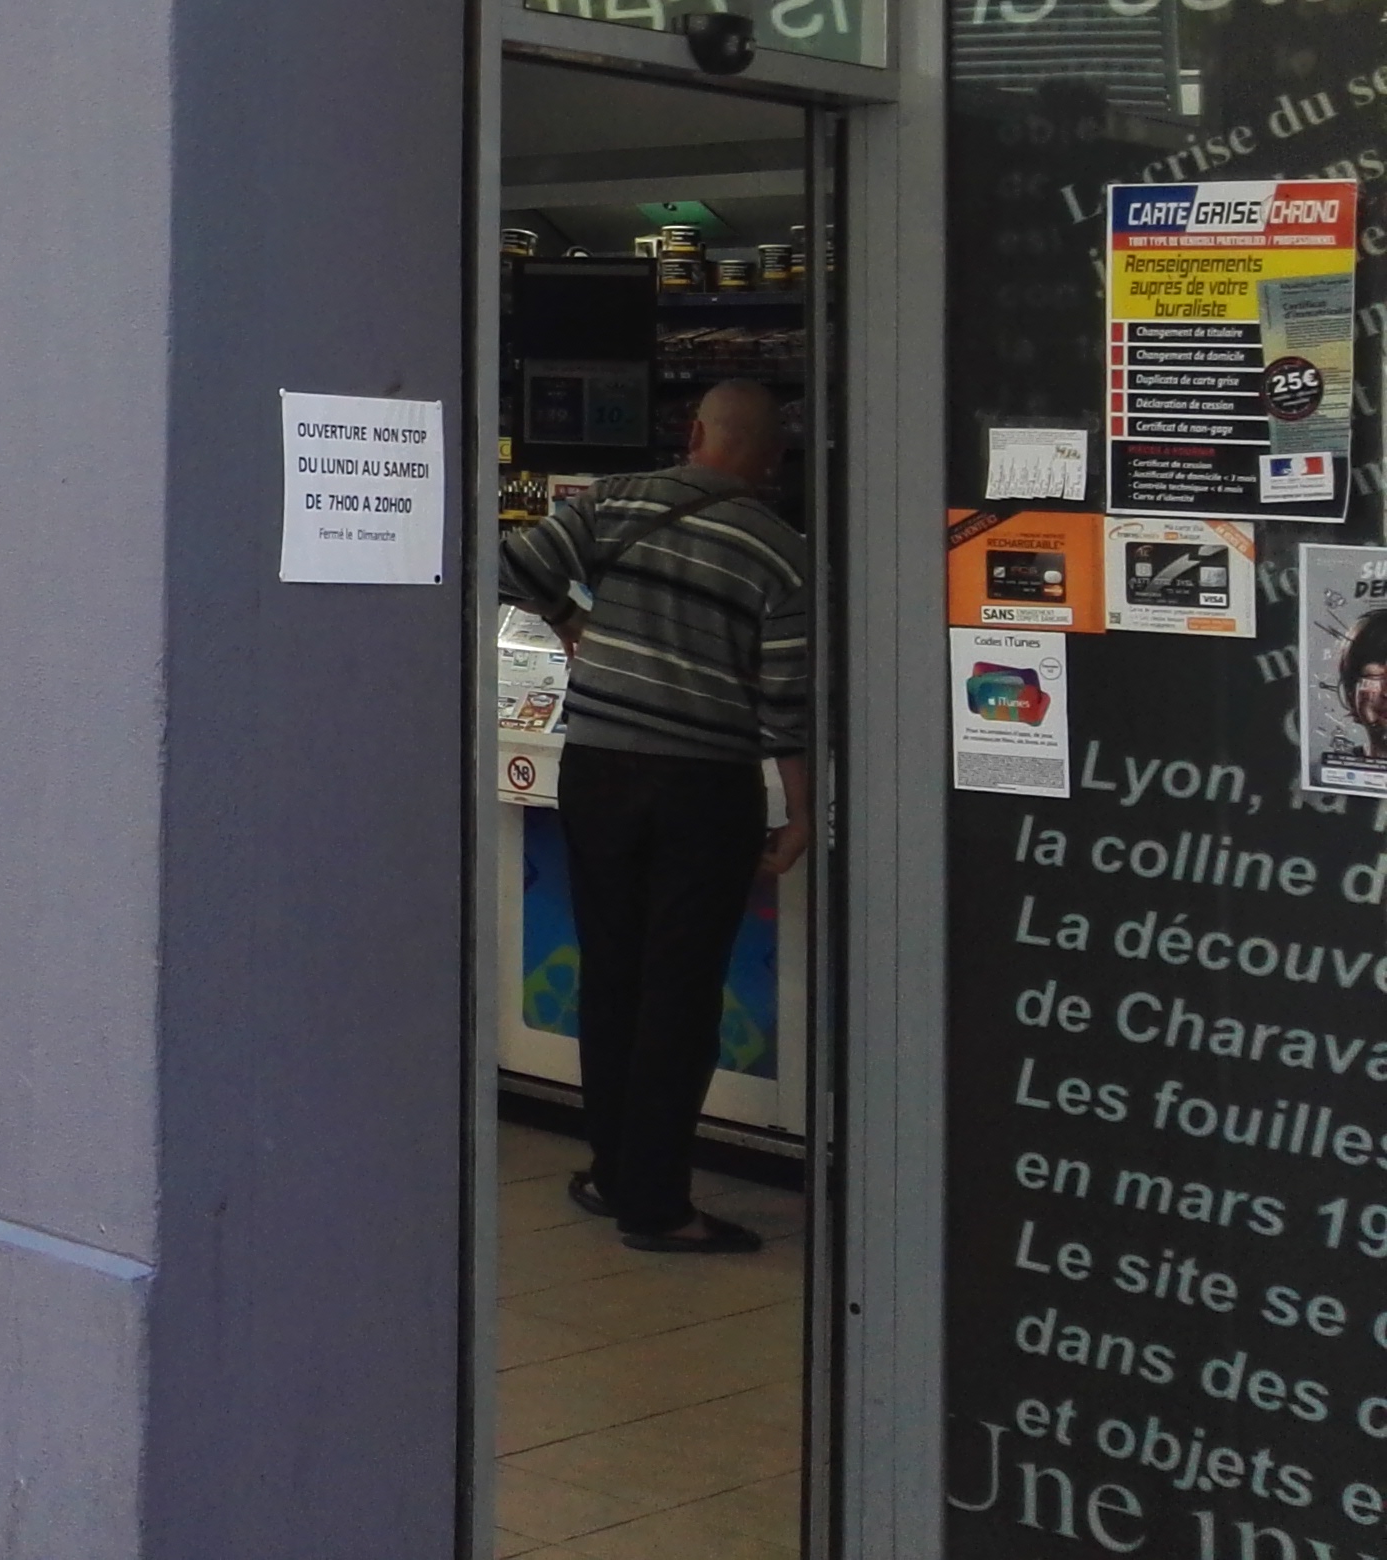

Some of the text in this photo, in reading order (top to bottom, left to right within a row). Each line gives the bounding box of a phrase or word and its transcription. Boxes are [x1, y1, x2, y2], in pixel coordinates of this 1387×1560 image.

[1267, 90, 1339, 139] du
[1128, 199, 1340, 226] CARTE GRISE CHRONO
[1125, 254, 1263, 278] Renseignements
[1130, 274, 1248, 300] auprès de votre
[1154, 298, 1227, 318] buraliste
[1135, 326, 1243, 341] Changement de titulaire
[1135, 349, 1245, 364] Changement de domicile
[1135, 374, 1240, 390] Duplicata de carte grise
[1271, 367, 1320, 394] 25€
[1135, 397, 1234, 411] Déclaration de cession
[297, 421, 427, 445] OUVERTURE NON STOP
[1135, 421, 1233, 437] Certificat de non-gage
[298, 456, 429, 479] DU LUNDI AU SAMEDI
[305, 493, 412, 514] DE 7H00 A 20H00
[319, 527, 396, 542] Fermé le Dimanche
[1203, 595, 1224, 604] VISA
[983, 608, 1015, 621] SANS
[974, 636, 1041, 649] Codes iTunes
[997, 697, 1031, 709] iTunes
[1080, 740, 1262, 815] Lyon,
[1015, 814, 1318, 896] la colline
[1015, 895, 1091, 952] La
[1015, 979, 1092, 1033] de
[1015, 1057, 1130, 1123] Les
[1015, 1150, 1387, 1259] en mars 19
[1015, 1220, 1347, 1338] Le site se
[1015, 1307, 1330, 1422] dans des
[1015, 1396, 1314, 1508] et objets
